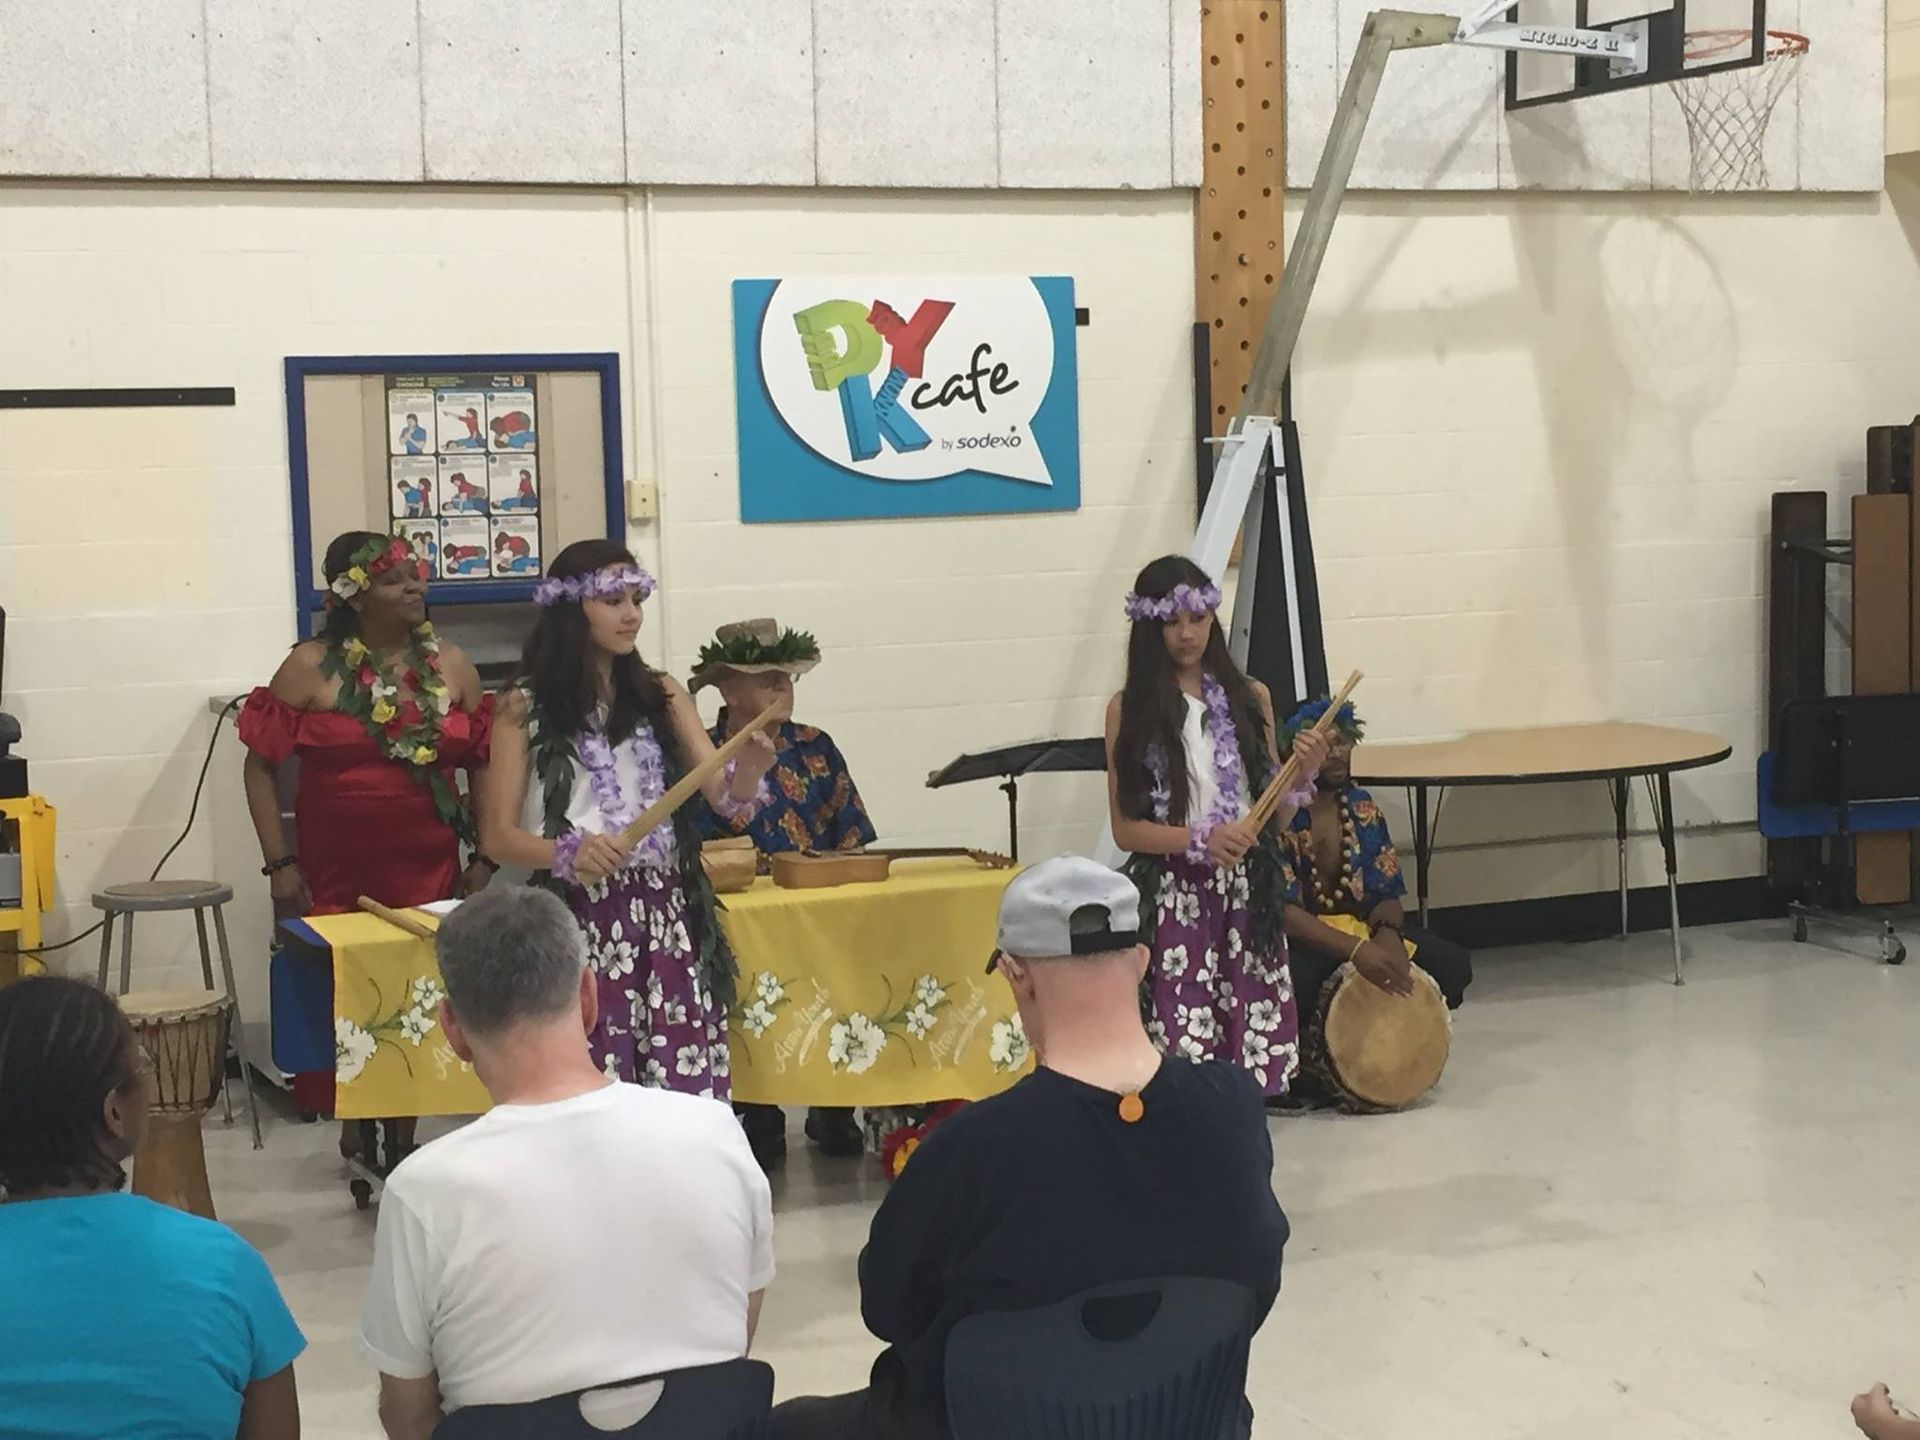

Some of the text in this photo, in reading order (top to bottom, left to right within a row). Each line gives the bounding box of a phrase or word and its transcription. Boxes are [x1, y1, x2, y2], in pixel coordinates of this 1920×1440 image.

[911, 342, 1019, 414] cafe
[941, 426, 1022, 452] by sodexo
